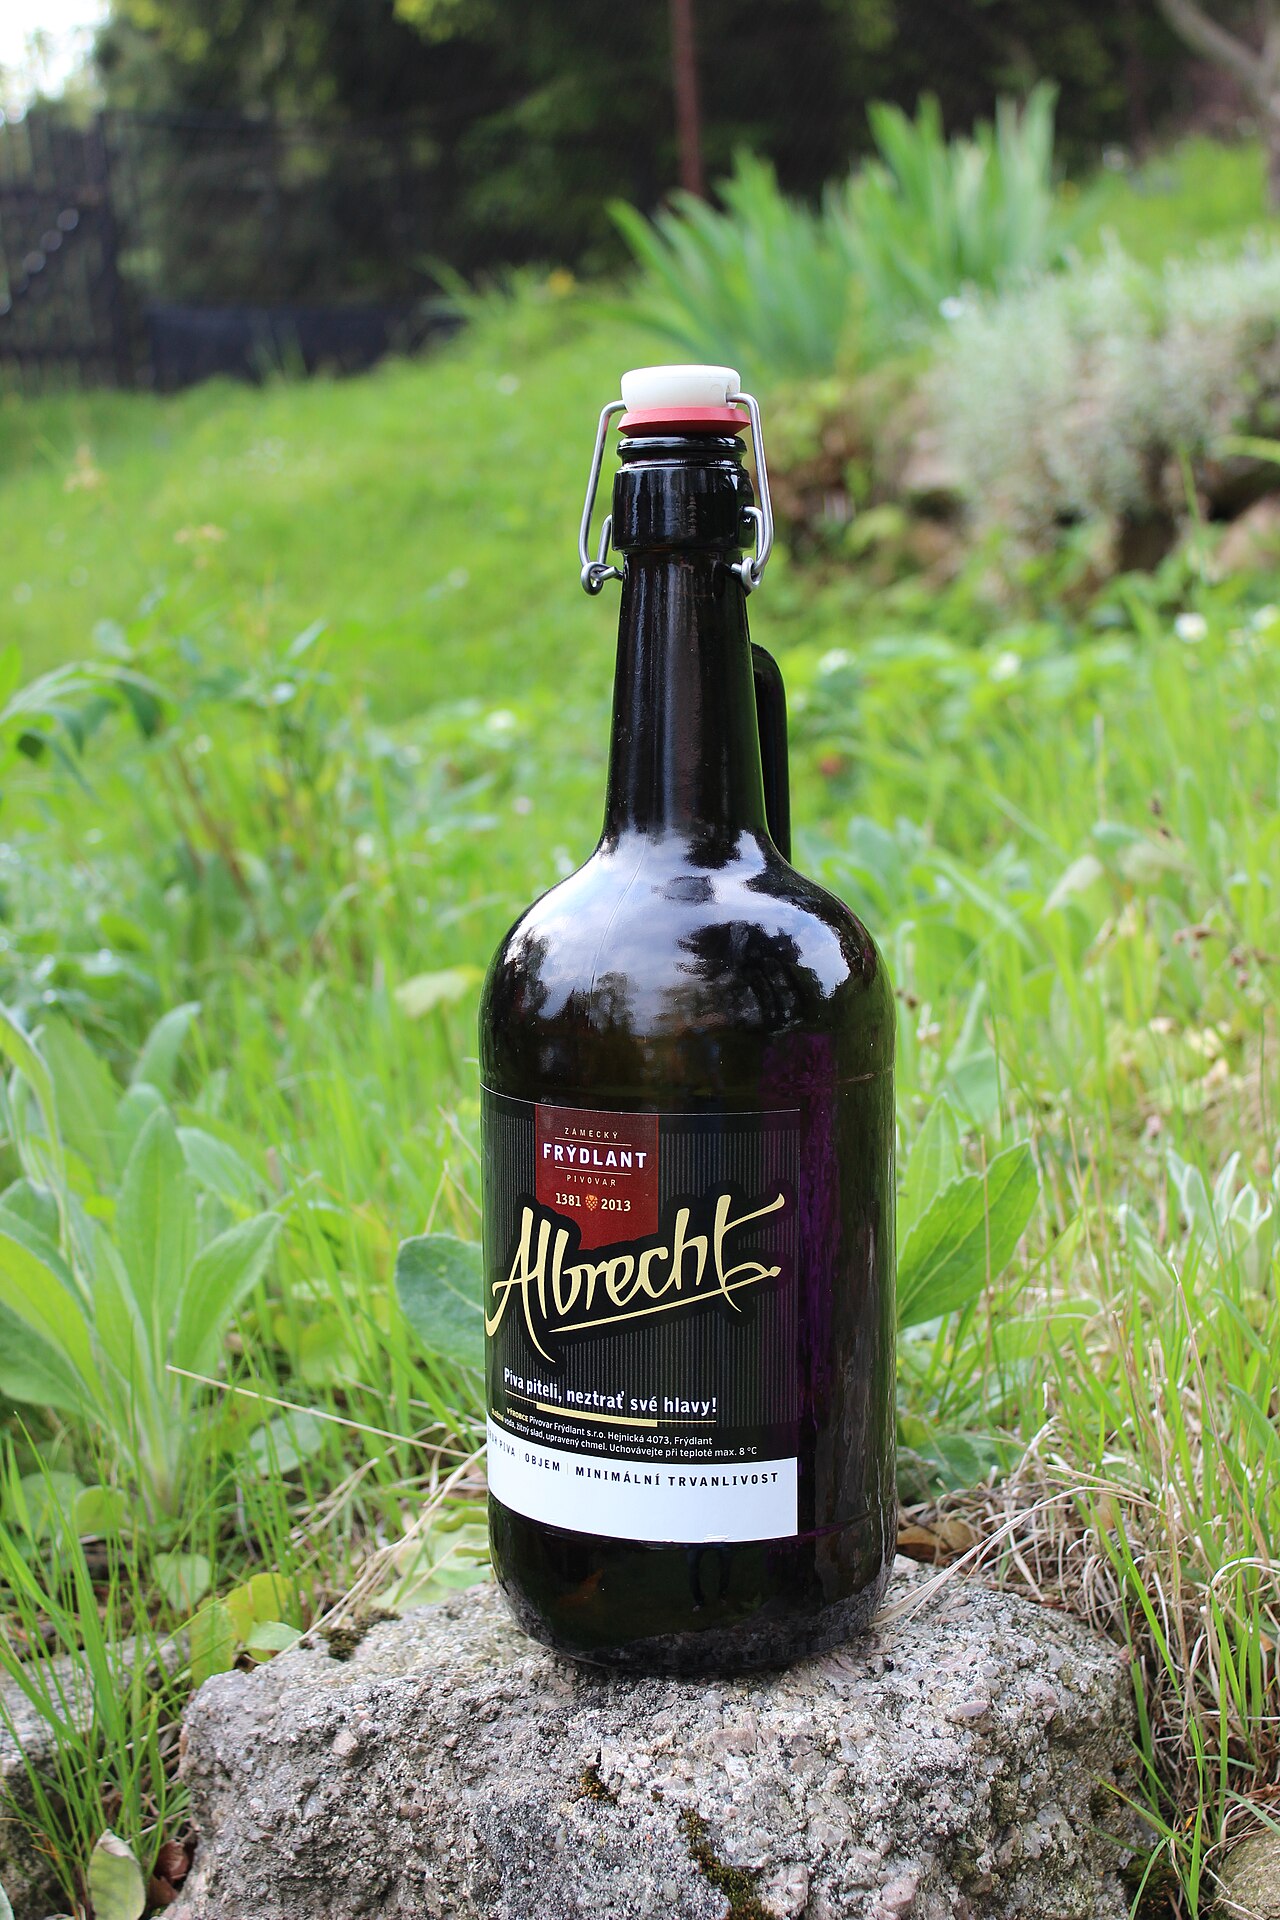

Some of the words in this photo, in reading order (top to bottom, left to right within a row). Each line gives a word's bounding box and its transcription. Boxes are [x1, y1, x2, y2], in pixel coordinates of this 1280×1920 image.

[543, 1142, 647, 1169] FRÝDLANT
[566, 1174, 616, 1187] PIVOVAR
[555, 1192, 581, 1207] 1381
[601, 1198, 631, 1212] 2013
[485, 1193, 785, 1363] Albrecht
[504, 1367, 524, 1390] Piva
[526, 1379, 563, 1404] piteli,
[567, 1388, 625, 1410] neztrať
[630, 1396, 658, 1412] své
[664, 1397, 718, 1417] hlavy!
[529, 1415, 553, 1430] Pivovar
[553, 1422, 585, 1436] Frýdlant
[586, 1429, 606, 1439] s.r.o.
[607, 1431, 645, 1443] Hejnická
[674, 1436, 713, 1447] Frýdlant
[530, 1428, 545, 1440] slad,
[545, 1433, 580, 1448] upravený
[580, 1439, 608, 1451] chmel.
[609, 1443, 663, 1457] Uchovávejte
[665, 1448, 678, 1458] při
[714, 1449, 737, 1457] max.
[739, 1447, 745, 1456] 8
[524, 1453, 560, 1472] OBJEM
[575, 1466, 661, 1486] MINIMÁLNÍ
[668, 1472, 779, 1487] TRVANLIVOST
